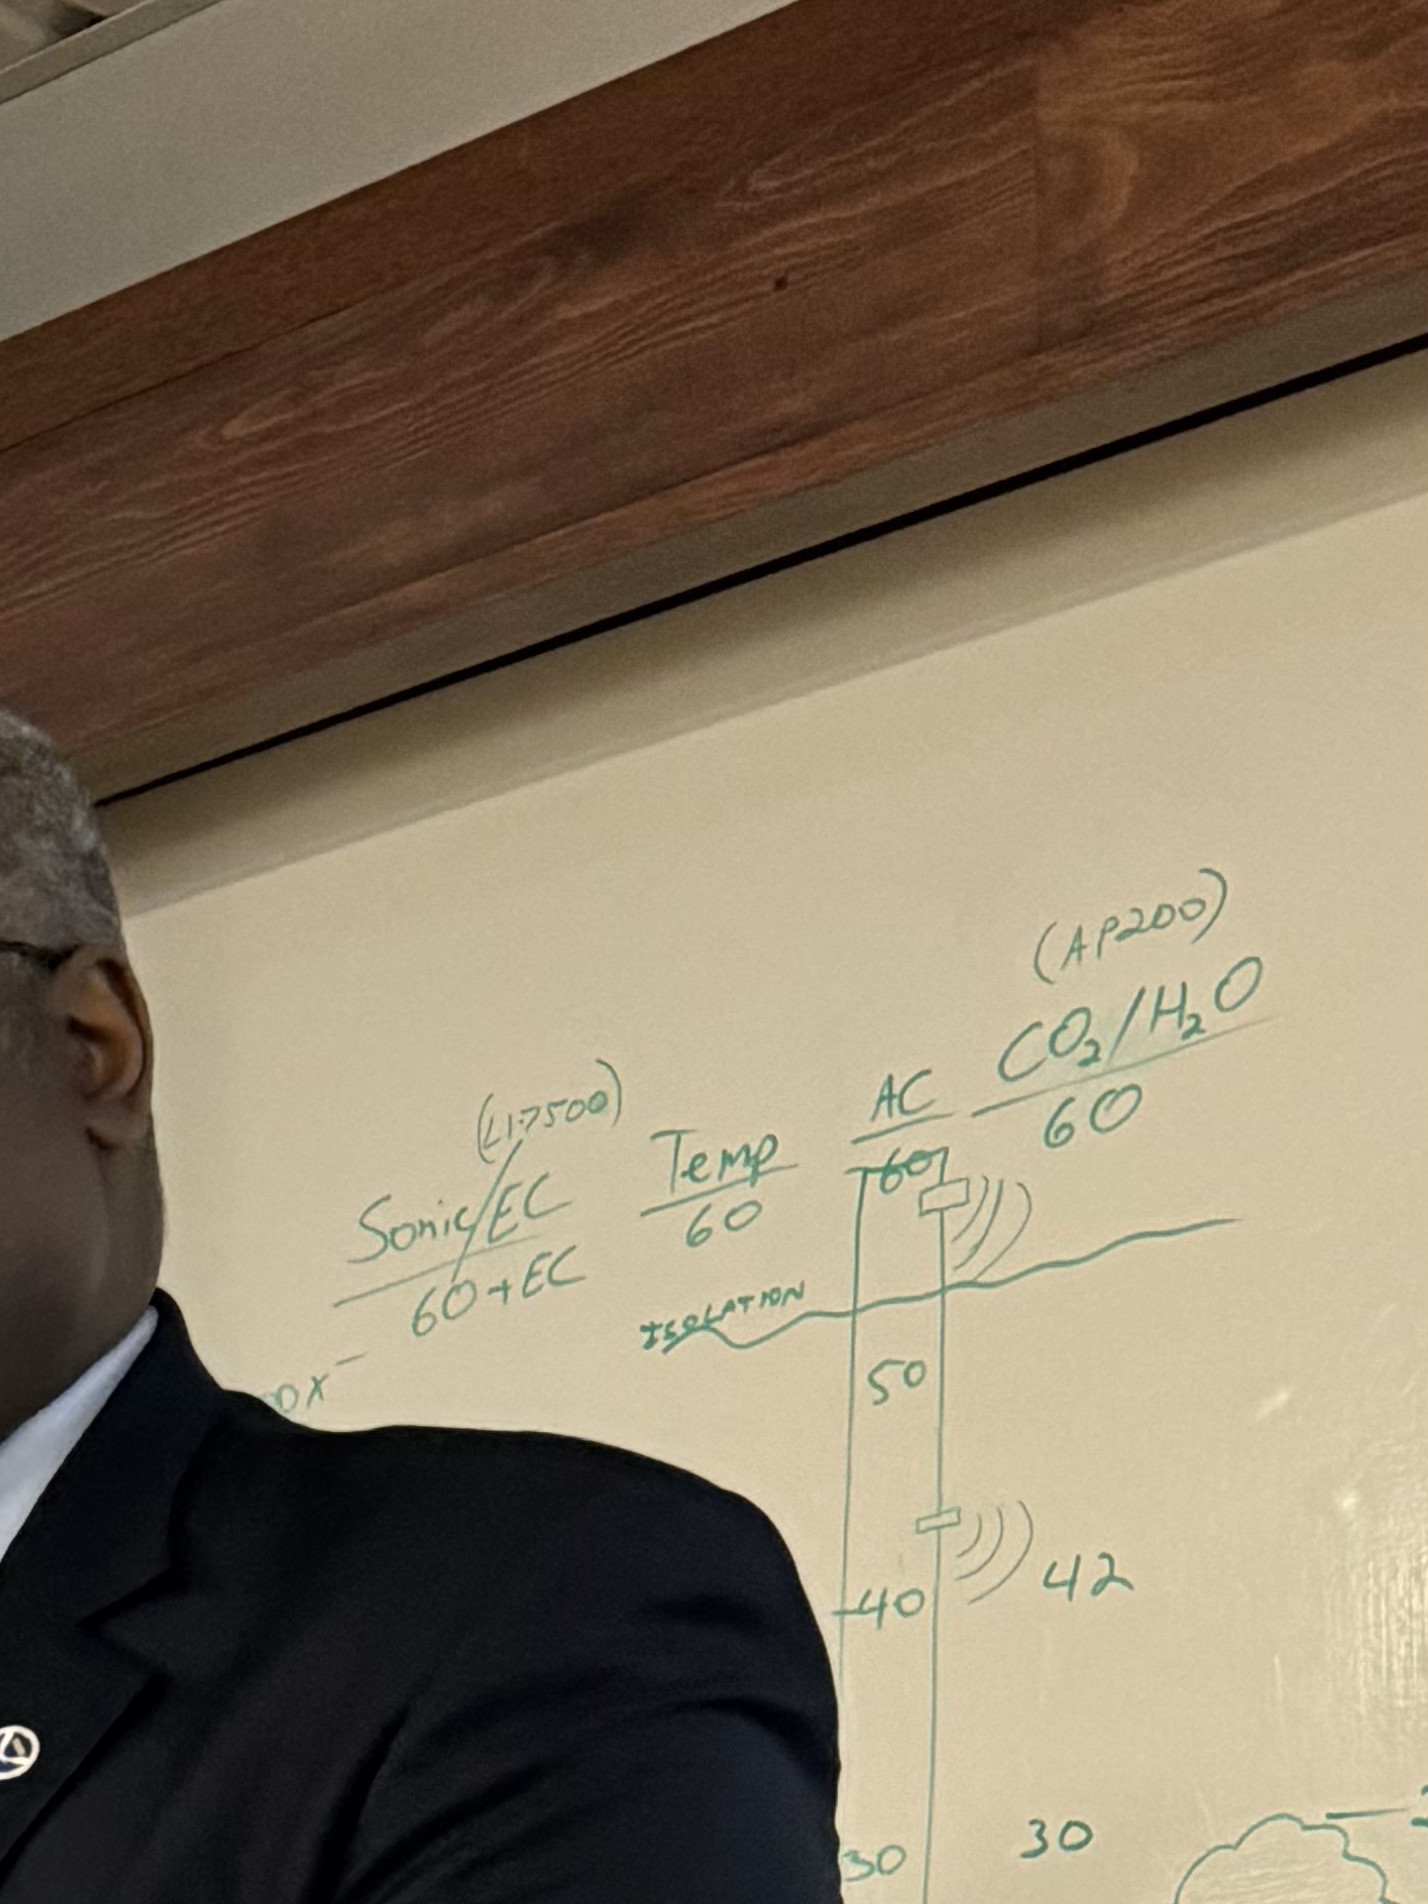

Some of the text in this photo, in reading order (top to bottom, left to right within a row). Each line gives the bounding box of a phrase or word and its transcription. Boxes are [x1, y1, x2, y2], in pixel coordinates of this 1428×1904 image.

[1034, 867, 1228, 984] (AP200)
[870, 1068, 936, 1122] AC
[1043, 1083, 1143, 1149] 60
[650, 1128, 780, 1194] Temp
[878, 1147, 934, 1195] 60
[685, 1199, 763, 1249] 60
[640, 1280, 805, 1350] ISOLATION
[867, 1359, 927, 1406] 50
[1042, 1551, 1134, 1601] 42
[857, 1587, 926, 1630] 40
[841, 1843, 907, 1882] 30
[1020, 1818, 1094, 1858] 30
